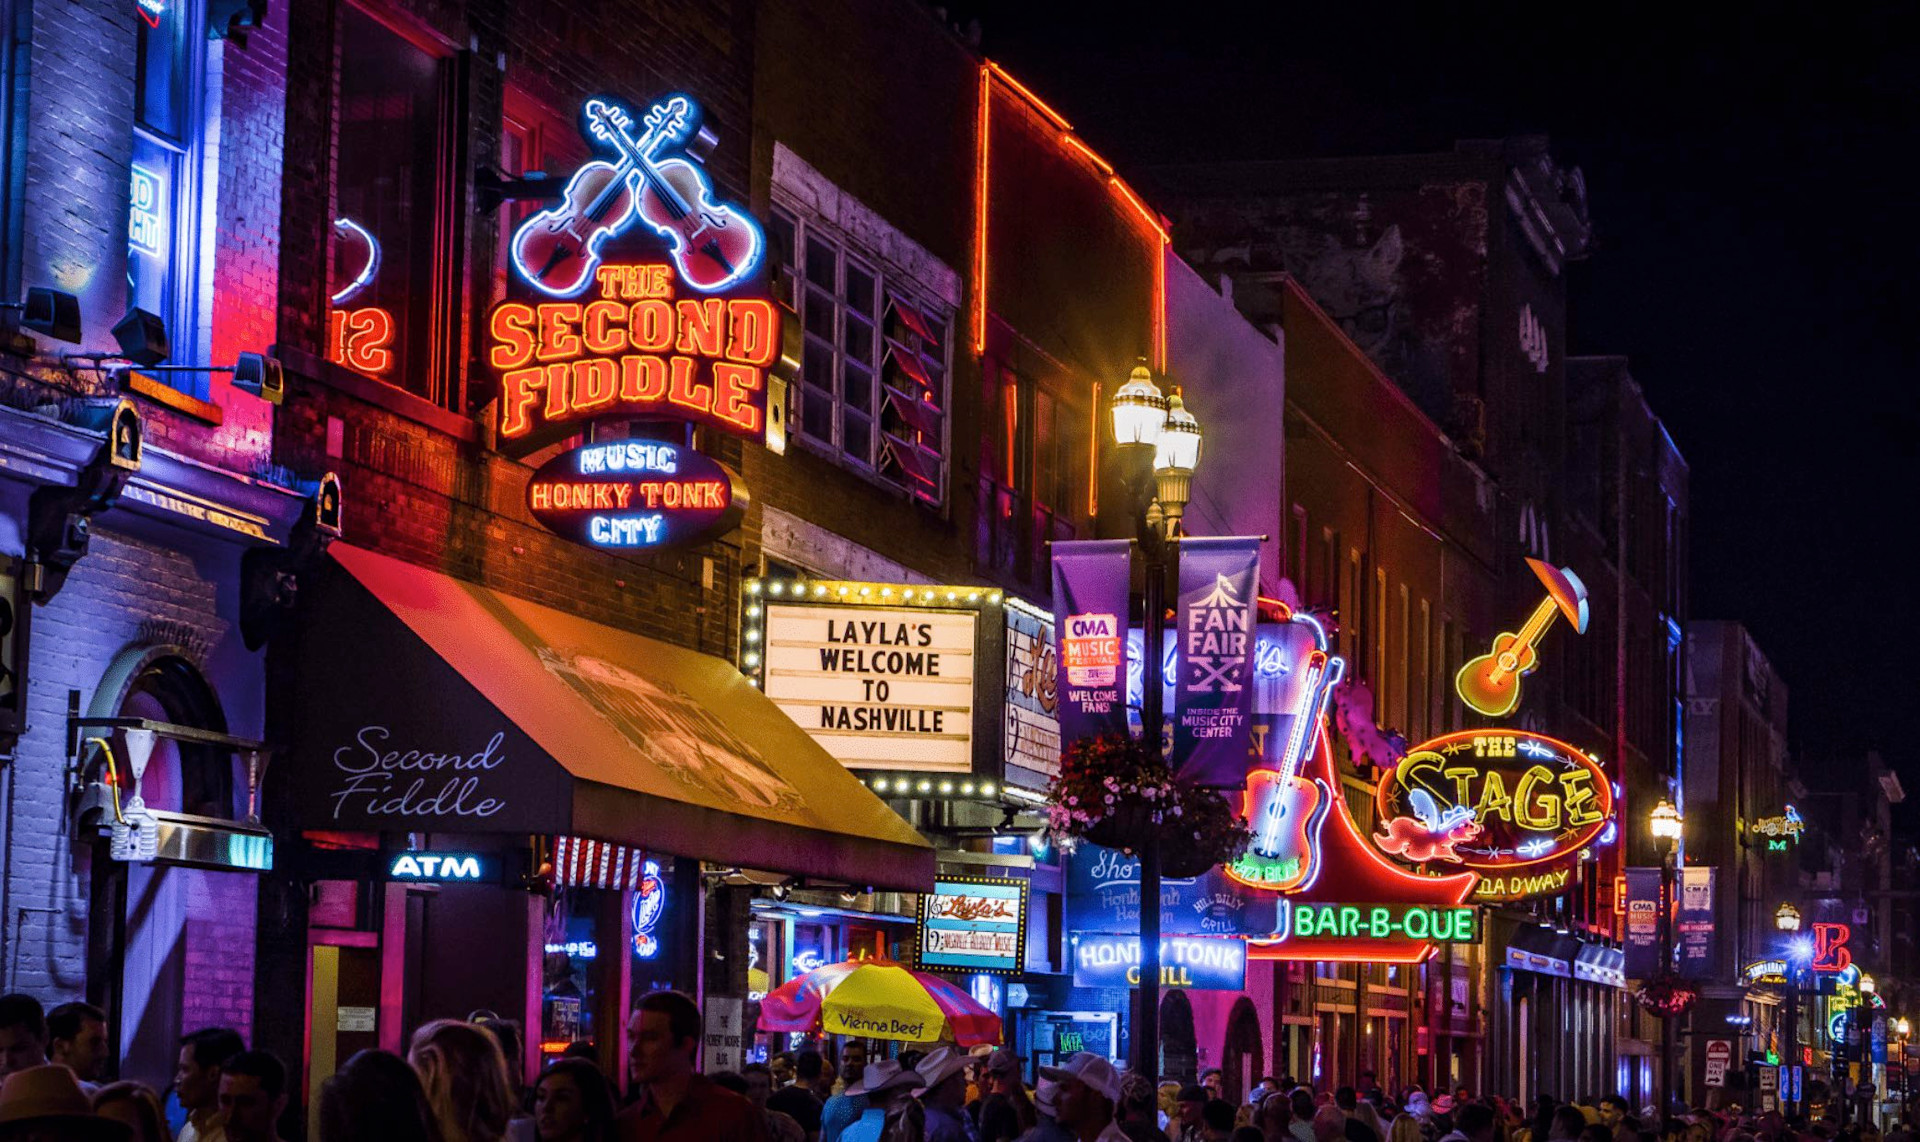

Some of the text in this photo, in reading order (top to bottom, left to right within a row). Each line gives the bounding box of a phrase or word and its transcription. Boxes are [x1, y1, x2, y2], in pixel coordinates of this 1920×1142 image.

[597, 264, 674, 299] THE
[490, 298, 781, 369] SECOND
[501, 354, 762, 436] FIDDLE
[580, 443, 677, 475] MUSIC
[531, 482, 726, 510] HONKY TONK
[591, 514, 663, 545] CITY
[828, 619, 932, 647] LAYLA'S
[1072, 620, 1110, 637] CMA
[1188, 609, 1249, 632] FAN
[1068, 640, 1115, 657] MUSIC
[1187, 632, 1247, 655] FAIR
[820, 648, 940, 676] WELCOME
[862, 678, 890, 702] TO
[1068, 690, 1119, 703] WELCOME
[821, 706, 944, 733] NASHVILLE
[1181, 715, 1244, 727] MUSIC CITY
[1192, 727, 1233, 738] CENTER
[333, 725, 506, 774] Second
[1473, 736, 1516, 758] THE
[330, 771, 506, 819] Fiddle
[1397, 750, 1605, 831] STAGE
[391, 855, 481, 878] ATM
[941, 893, 1014, 920] Layla's
[1192, 897, 1215, 914] HILL
[1215, 893, 1245, 910] BILLY
[1633, 903, 1653, 911] CMA
[1200, 916, 1237, 932] GRILL
[1295, 906, 1473, 940] BAR-B-QUE
[1172, 940, 1241, 971] TONK
[1125, 966, 1193, 985] GILL
[839, 1013, 925, 1039] Vienna Beef
